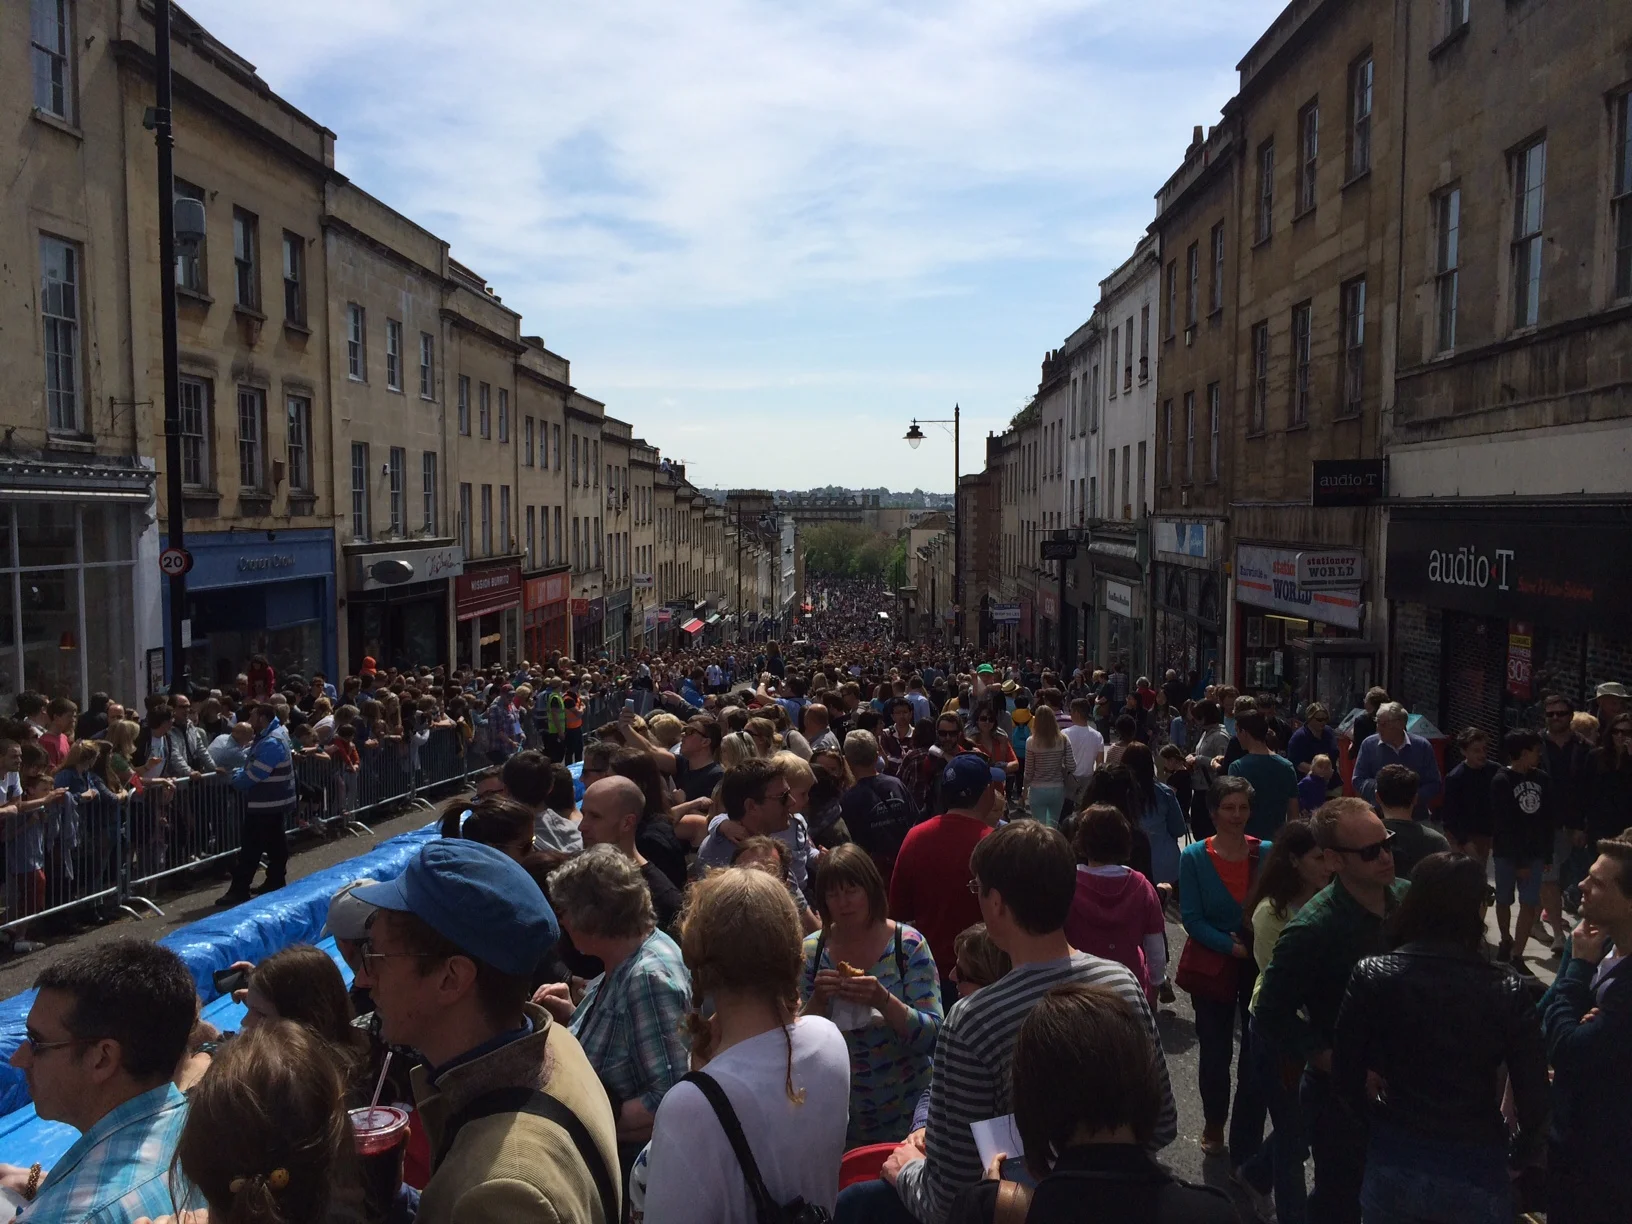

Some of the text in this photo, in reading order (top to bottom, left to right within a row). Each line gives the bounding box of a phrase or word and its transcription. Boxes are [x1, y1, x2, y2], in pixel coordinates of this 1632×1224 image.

[1320, 474, 1377, 487] audio T
[163, 556, 183, 568] 20
[1306, 556, 1356, 567] stationery
[1309, 566, 1354, 577] WORLD
[1428, 545, 1489, 588] audio
[1495, 548, 1514, 591] T
[471, 574, 509, 591] MISSION BURRITO
